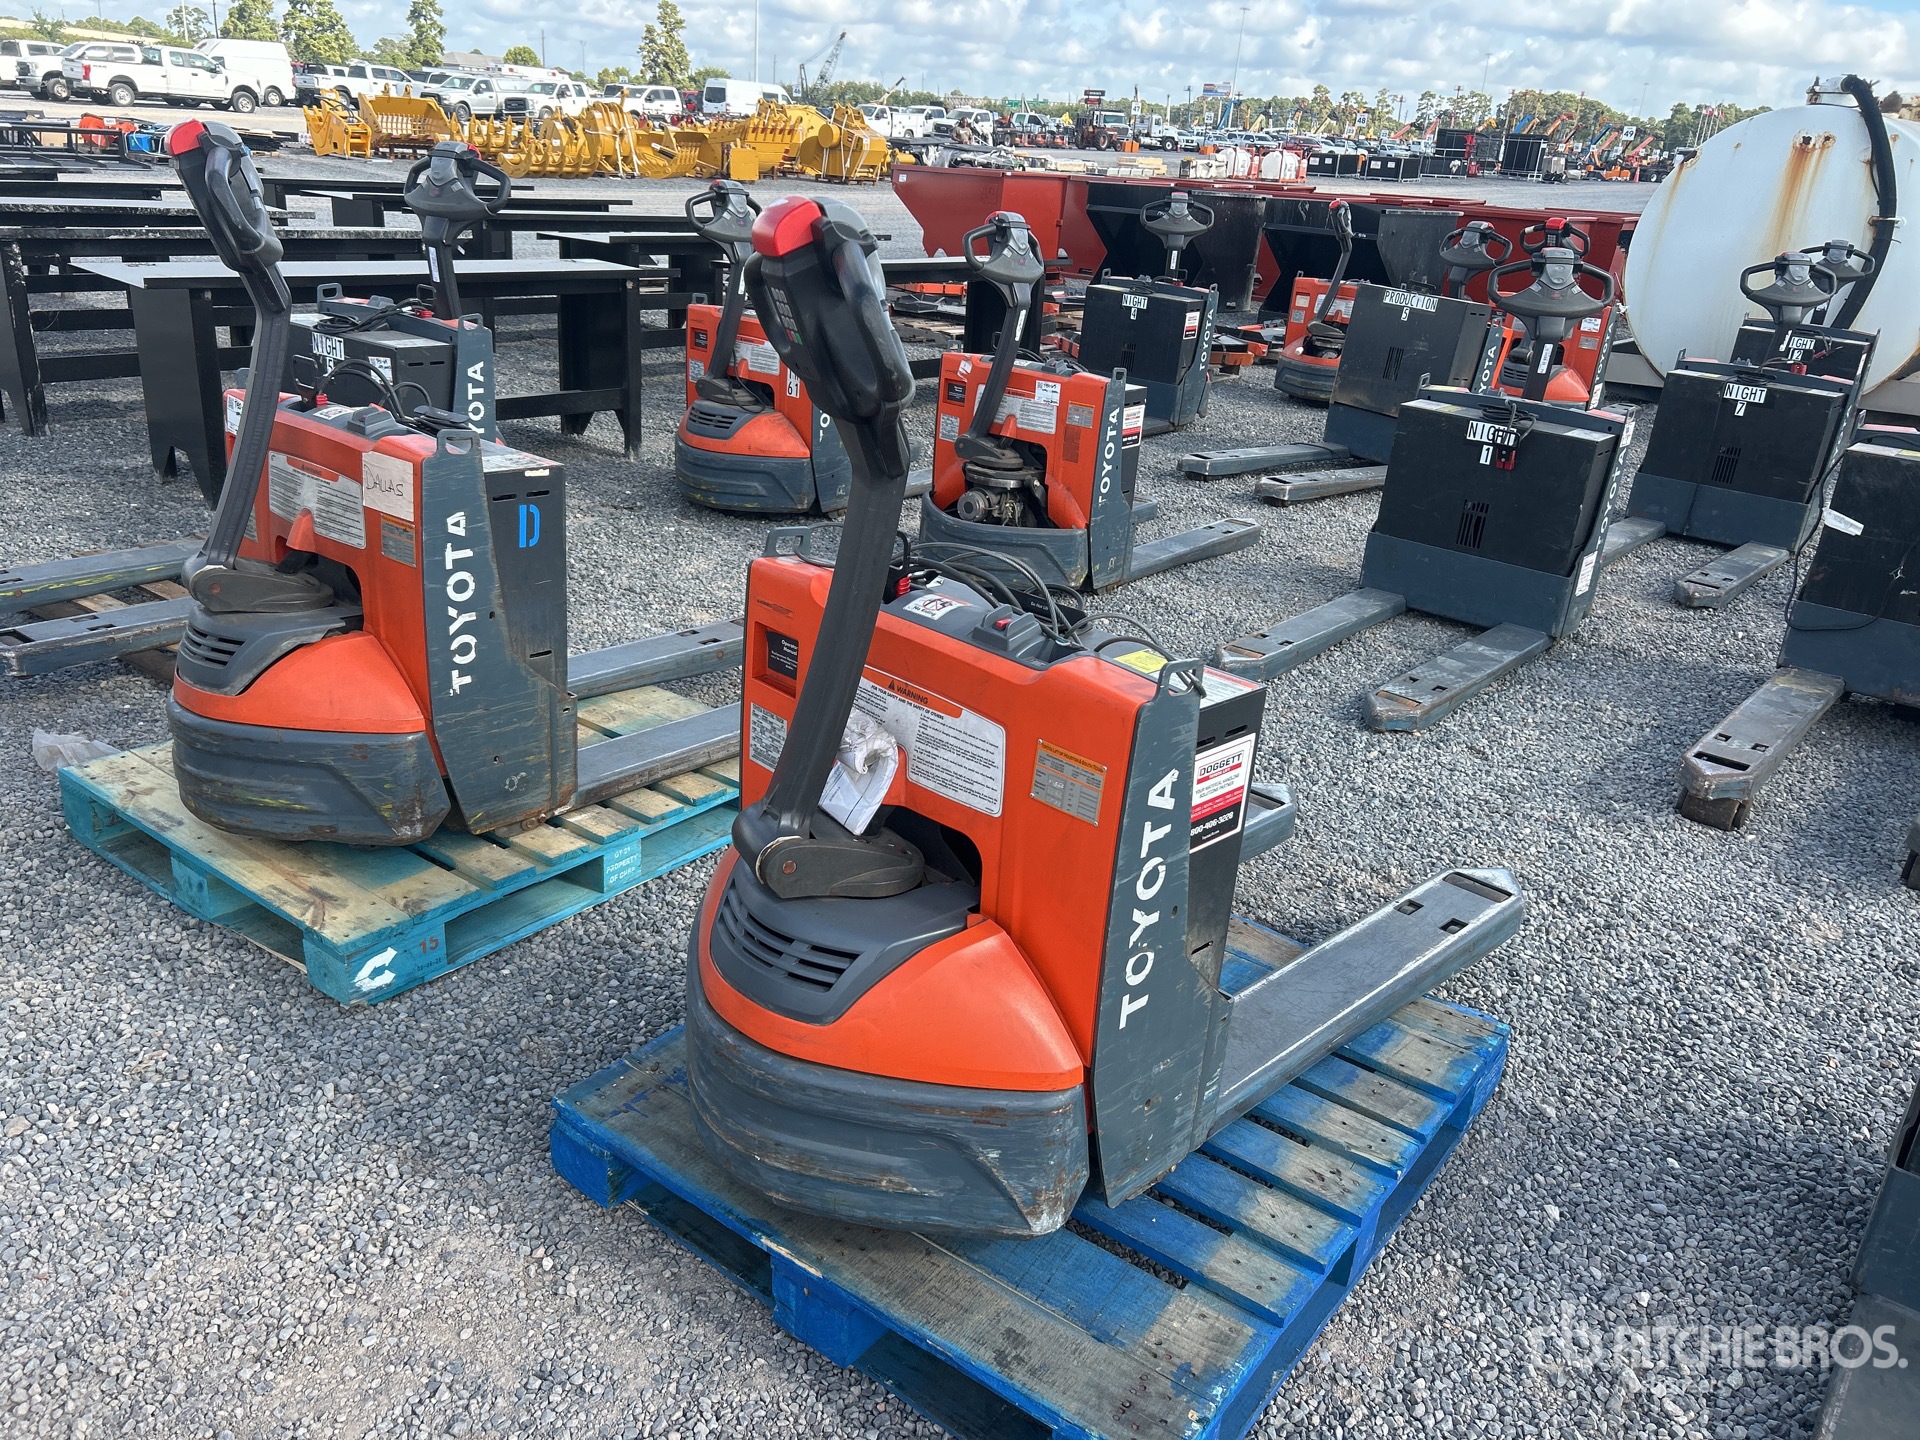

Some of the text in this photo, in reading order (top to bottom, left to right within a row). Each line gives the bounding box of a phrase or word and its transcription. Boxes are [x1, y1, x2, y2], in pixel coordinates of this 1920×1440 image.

[1623, 130, 1634, 138] 49
[1122, 294, 1148, 309] NIGHT
[1384, 290, 1438, 311] PRODUCTION
[1131, 308, 1137, 319] 4
[1402, 308, 1409, 320] 5
[312, 333, 344, 360] NIGHT
[1199, 308, 1214, 371] TOYOTA
[1791, 337, 1815, 350] IGHT
[1595, 322, 1613, 383] TOYOTA
[326, 357, 335, 375] 5
[1478, 345, 1497, 393] YOTA
[468, 361, 485, 434] YOTA
[787, 381, 799, 397] 61
[1725, 384, 1767, 403] NIGHT
[1737, 402, 1745, 414] 7
[1099, 407, 1120, 508] TOYOTA
[1484, 447, 1491, 463] 1
[364, 464, 404, 497] DALLAS
[1596, 447, 1628, 548] TOYOTA
[519, 504, 540, 548] D
[445, 511, 478, 696] TOYOTA
[878, 687, 887, 695] YOUR
[887, 690, 899, 700] SAFETY
[912, 701, 925, 712] SAFETY
[930, 709, 944, 720] OTHERS
[896, 684, 929, 705] WARNING
[1200, 753, 1242, 776] DOGGETT
[606, 853, 639, 874] PROPERTY
[610, 874, 619, 883] OF
[1119, 768, 1180, 1030] TOYOTA
